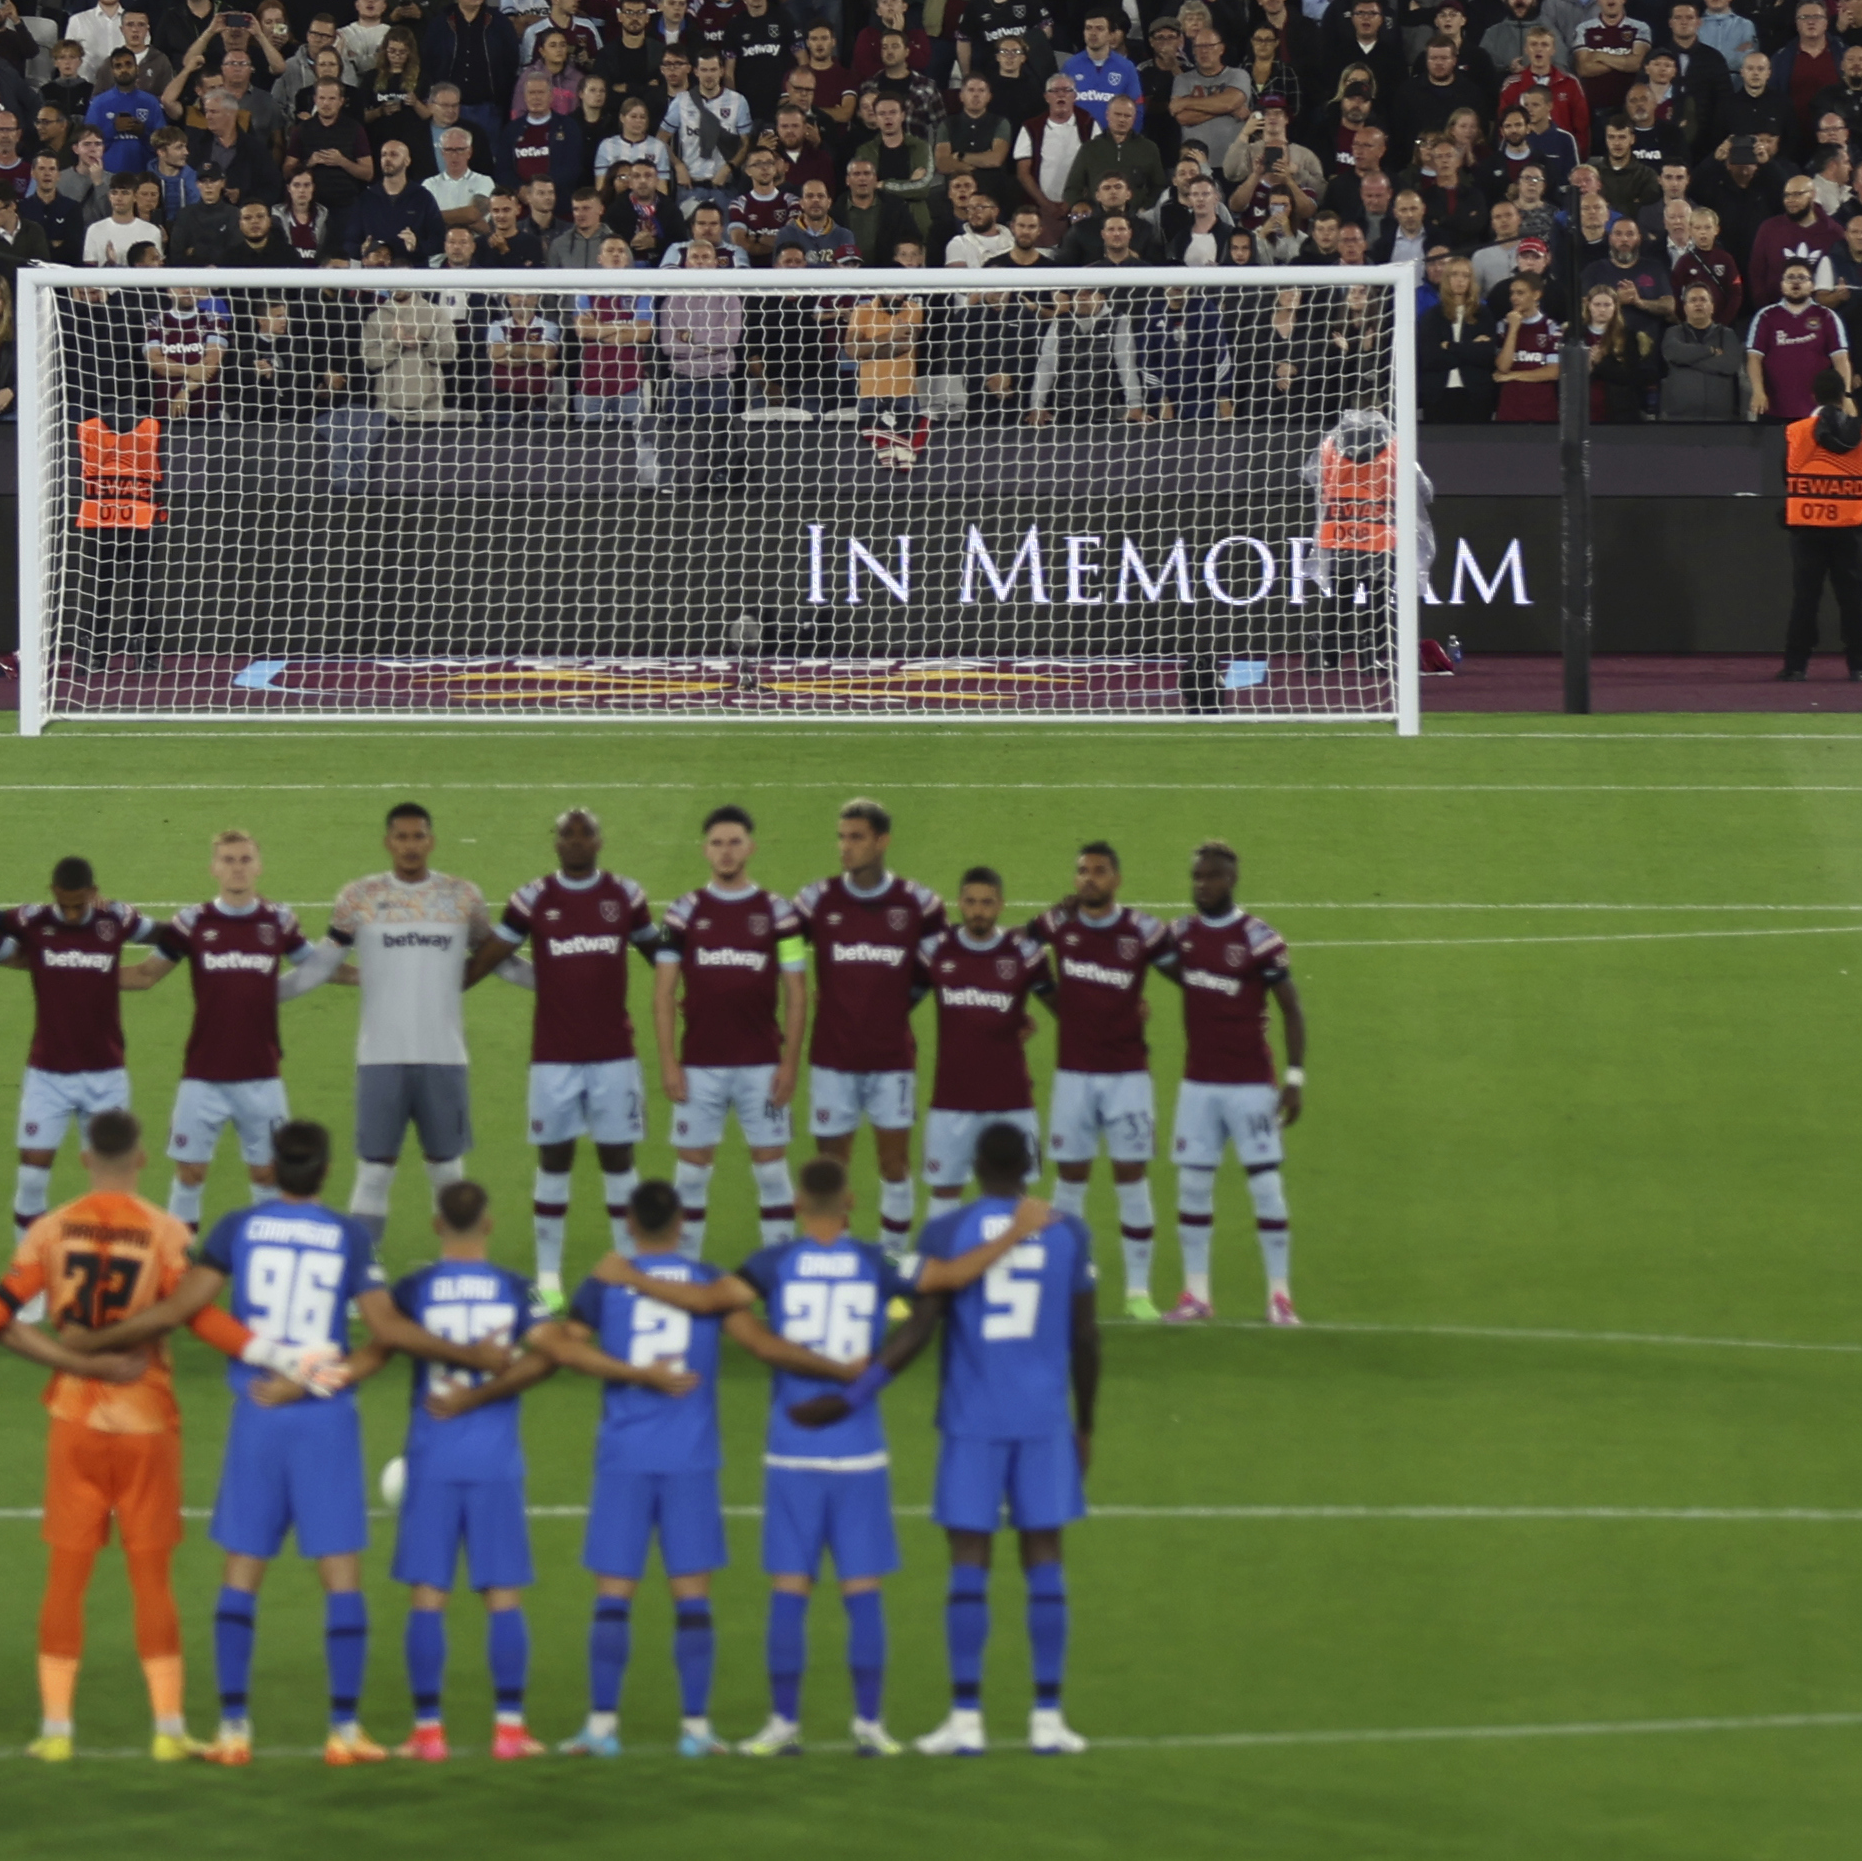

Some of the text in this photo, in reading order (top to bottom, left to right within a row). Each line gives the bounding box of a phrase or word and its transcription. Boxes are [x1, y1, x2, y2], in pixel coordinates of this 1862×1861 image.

[741, 43, 779, 57] betway
[1799, 502, 1838, 522] 078
[961, 524, 1533, 606] MEMOM
[383, 931, 454, 951] betway
[549, 933, 620, 959] betway
[43, 948, 114, 974] betway
[204, 951, 275, 975] betway
[696, 946, 767, 972] betway
[833, 942, 906, 968] betway
[1062, 959, 1133, 990] betway
[942, 986, 1014, 1012] betway
[245, 1247, 346, 1345] 96
[981, 1245, 1046, 1341] 5
[782, 1281, 876, 1363] 26
